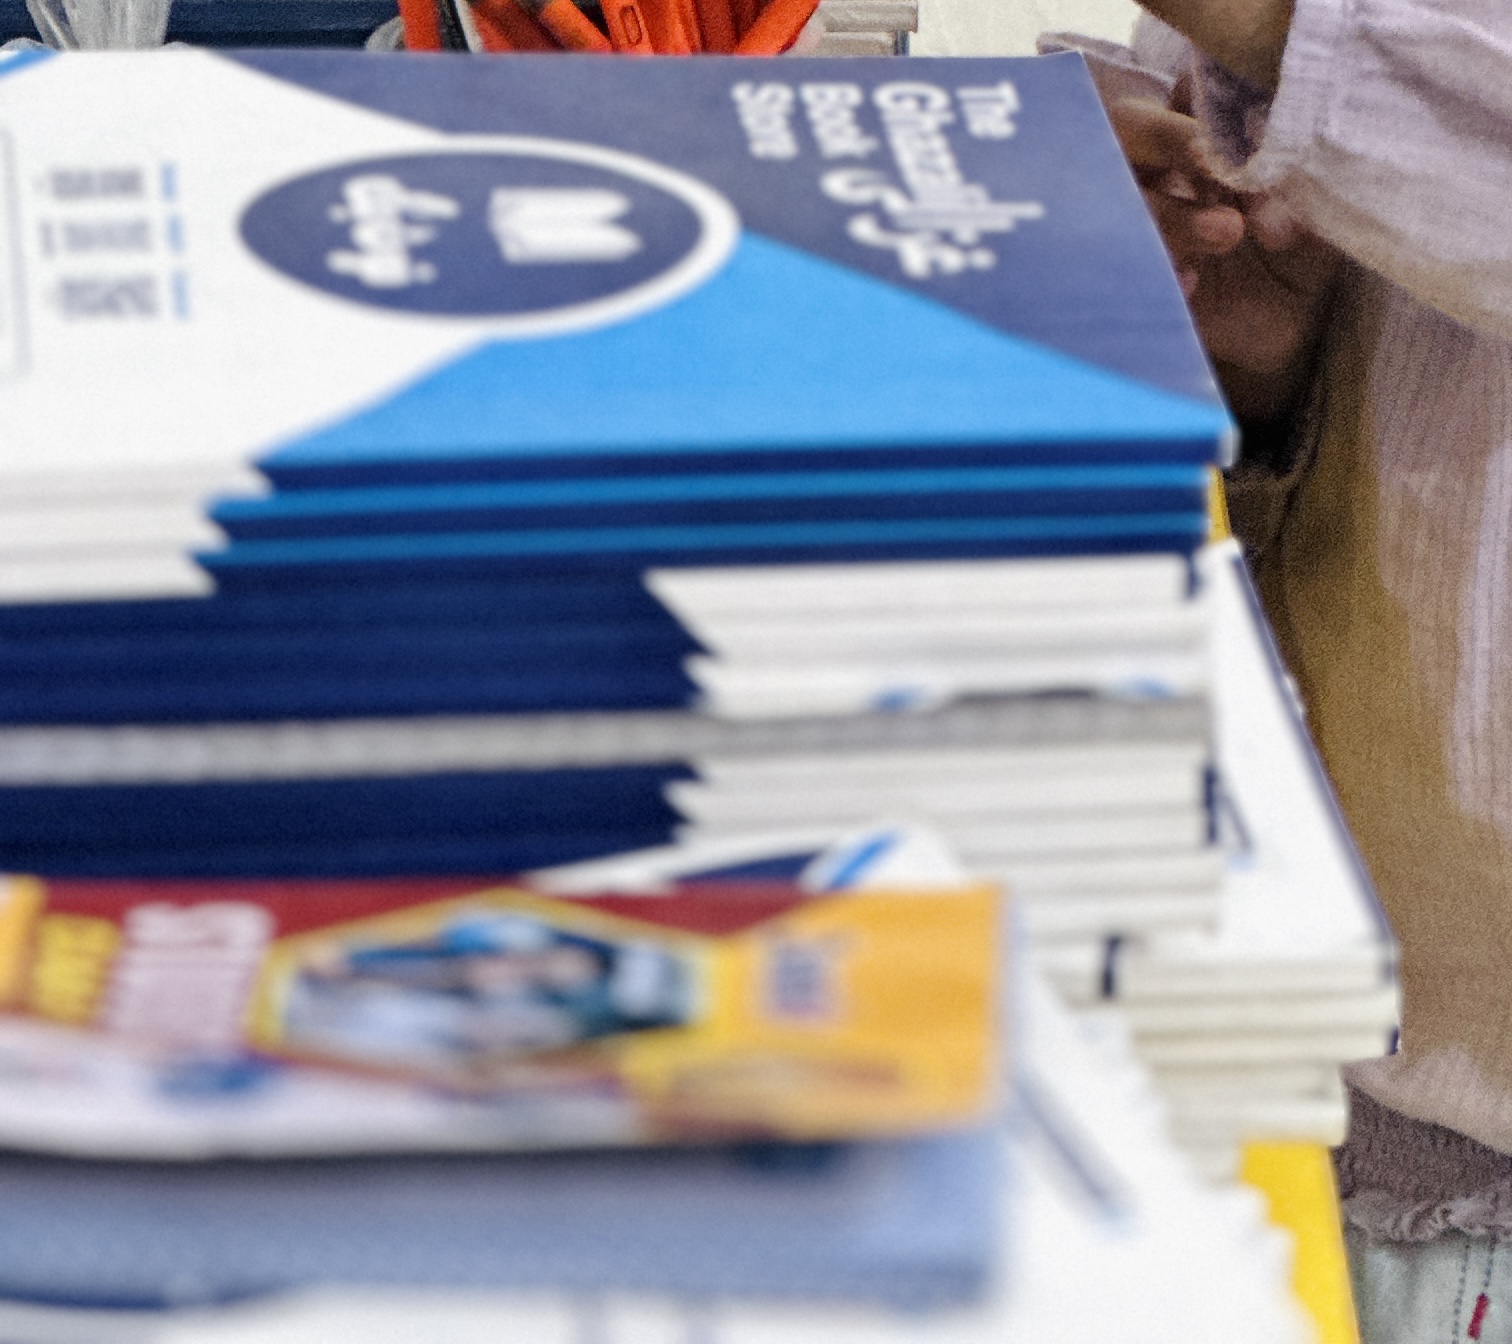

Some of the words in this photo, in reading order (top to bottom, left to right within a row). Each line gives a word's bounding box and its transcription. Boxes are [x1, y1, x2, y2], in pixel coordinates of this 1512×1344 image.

[731, 81, 798, 160] Store
[799, 81, 880, 160] Book
[955, 80, 1020, 140] The
